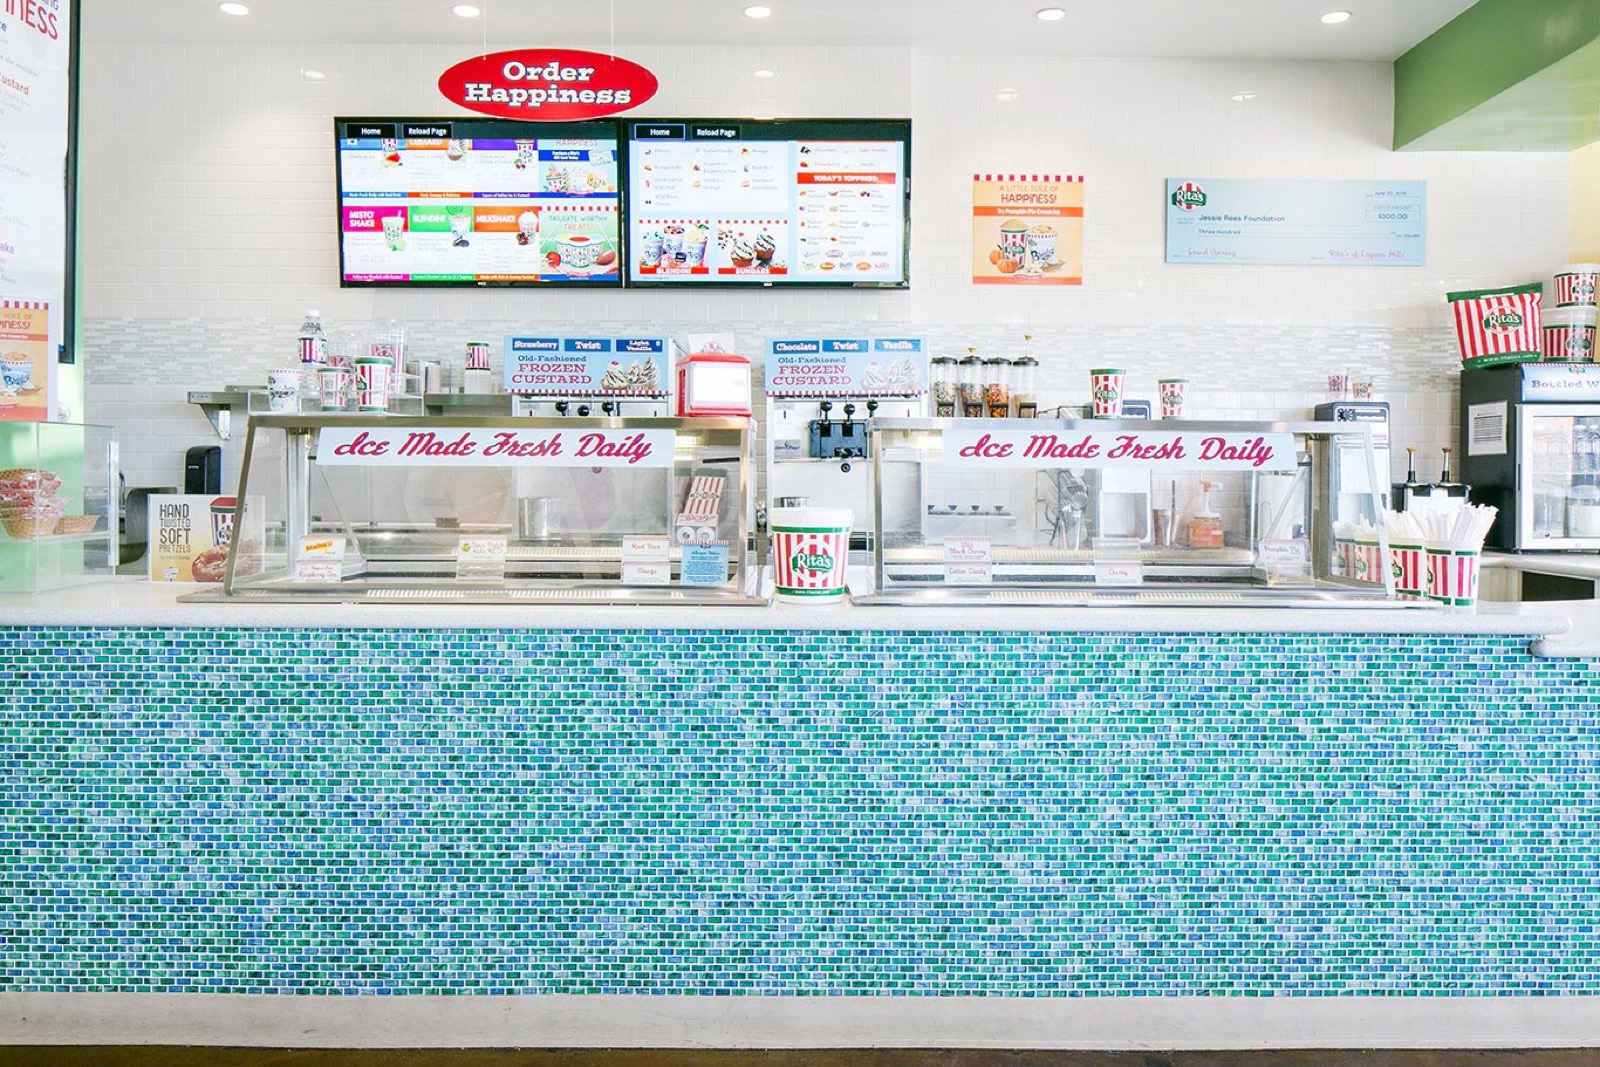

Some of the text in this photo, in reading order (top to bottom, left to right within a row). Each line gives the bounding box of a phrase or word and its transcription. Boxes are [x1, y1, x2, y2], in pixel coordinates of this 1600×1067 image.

[503, 61, 595, 81] Order
[0, 73, 29, 95] ustard
[464, 83, 632, 107] Happiness
[431, 128, 448, 136] Page
[719, 129, 736, 137] Page
[1001, 193, 1058, 204] HAPPINESS!
[1176, 190, 1204, 201] Rita's
[349, 219, 375, 227] SHAKE
[476, 215, 516, 223] MILKSHAKE
[1187, 247, 1209, 256] Grand
[1210, 248, 1237, 258] Opening
[1489, 314, 1519, 325] Rita's
[514, 341, 558, 350] Strawberry
[575, 341, 601, 350] Twist
[776, 343, 818, 351] Chocolate
[833, 341, 859, 350] Twist
[883, 341, 913, 349] Vanilla
[778, 356, 847, 364] Old-Fashioned
[518, 364, 586, 373] FROZEN
[779, 365, 846, 374] FROZEN
[512, 374, 592, 384] CUSTARD
[772, 376, 852, 385] CUSTARD
[1531, 379, 1583, 389] Bottled
[334, 431, 653, 464] Ice Made Fresh Daily
[959, 433, 1275, 467] Ice Made Fresh Daily
[159, 503, 190, 518] HAND
[160, 518, 191, 528] TWISTED
[160, 528, 191, 544] SOFT
[159, 544, 191, 554] PRETZELS
[796, 553, 832, 569] Rita's
